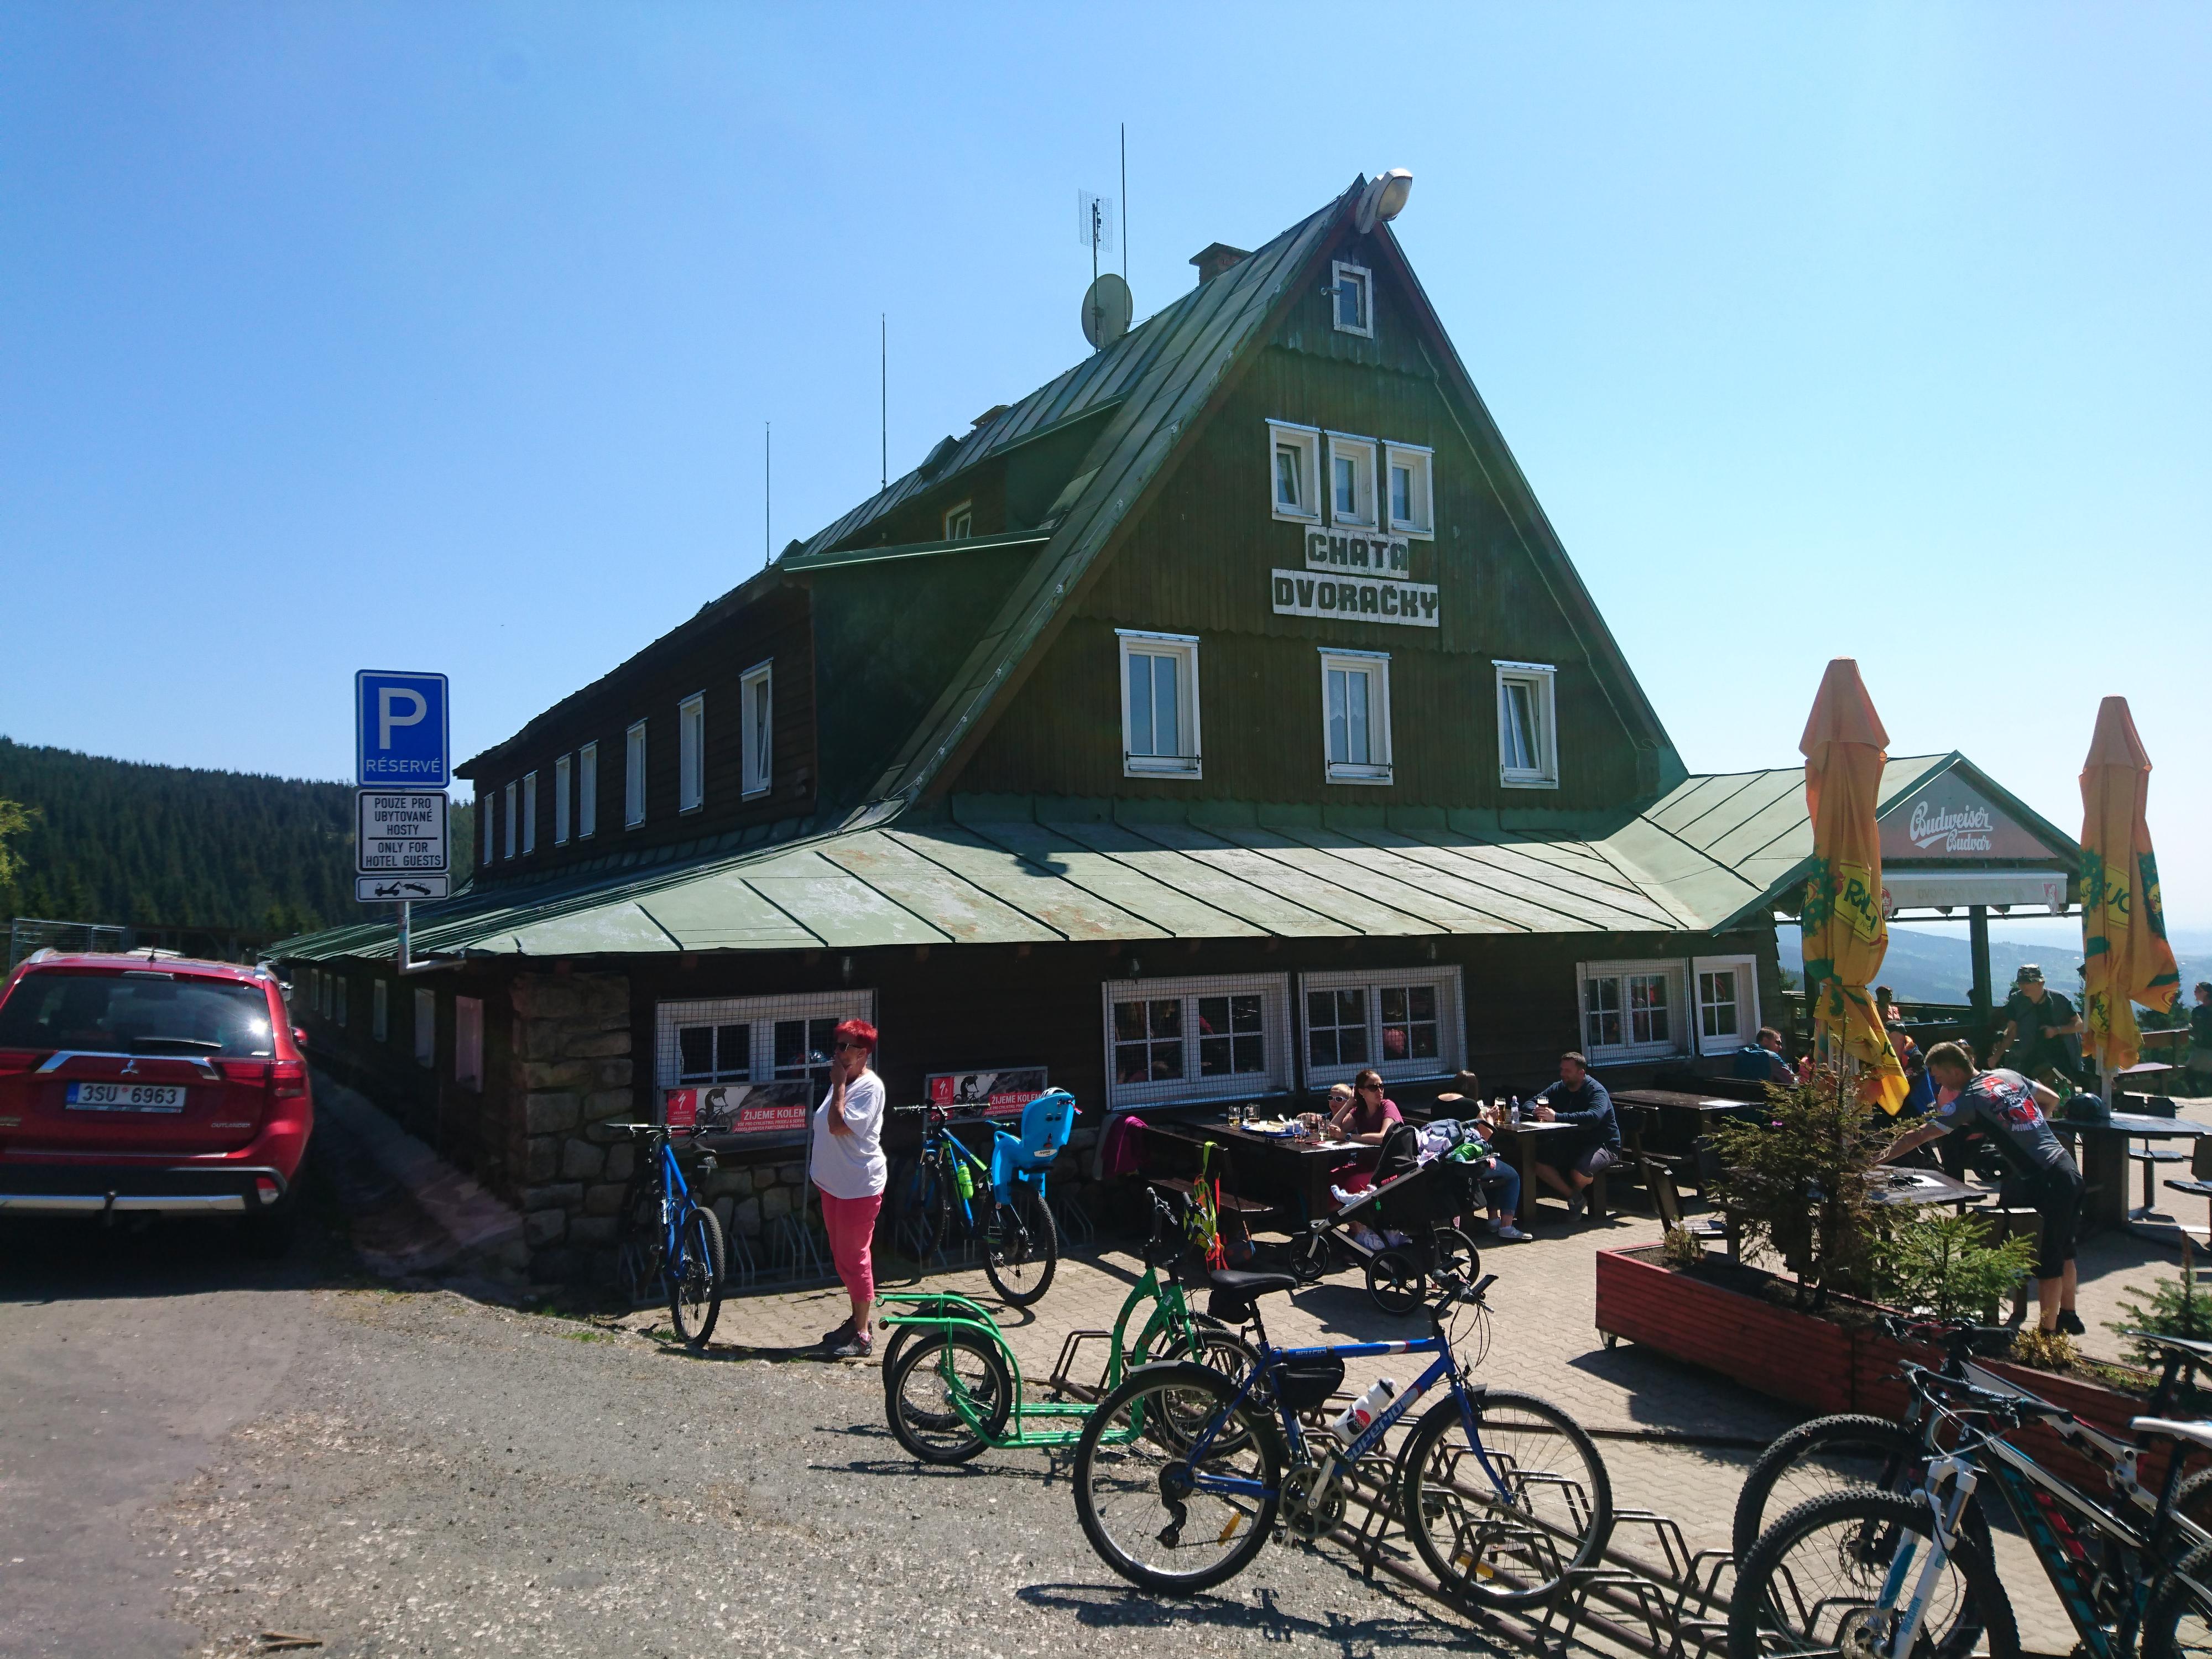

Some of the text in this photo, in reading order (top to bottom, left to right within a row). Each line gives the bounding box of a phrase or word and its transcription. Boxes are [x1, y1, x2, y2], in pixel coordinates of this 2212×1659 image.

[1307, 533, 1408, 571] CHATA
[1274, 577, 1438, 619] DVORAČKY
[379, 687, 427, 750] P
[366, 756, 441, 773] RÉSERVÉ
[374, 797, 431, 809] POUZE PRO
[374, 808, 432, 822] UBYTOVANÉ
[1910, 801, 1994, 841] Budweiser
[386, 825, 419, 836] HOSTY
[378, 842, 429, 853] ONLY FOR
[1946, 828, 1992, 852] Budvar
[366, 855, 441, 867] HOTEL GUESTS
[82, 1086, 178, 1104] 3SU 6963
[991, 1095, 1016, 1105] ŽIJEME
[744, 1108, 806, 1120] ŽIJEME KOLEM
